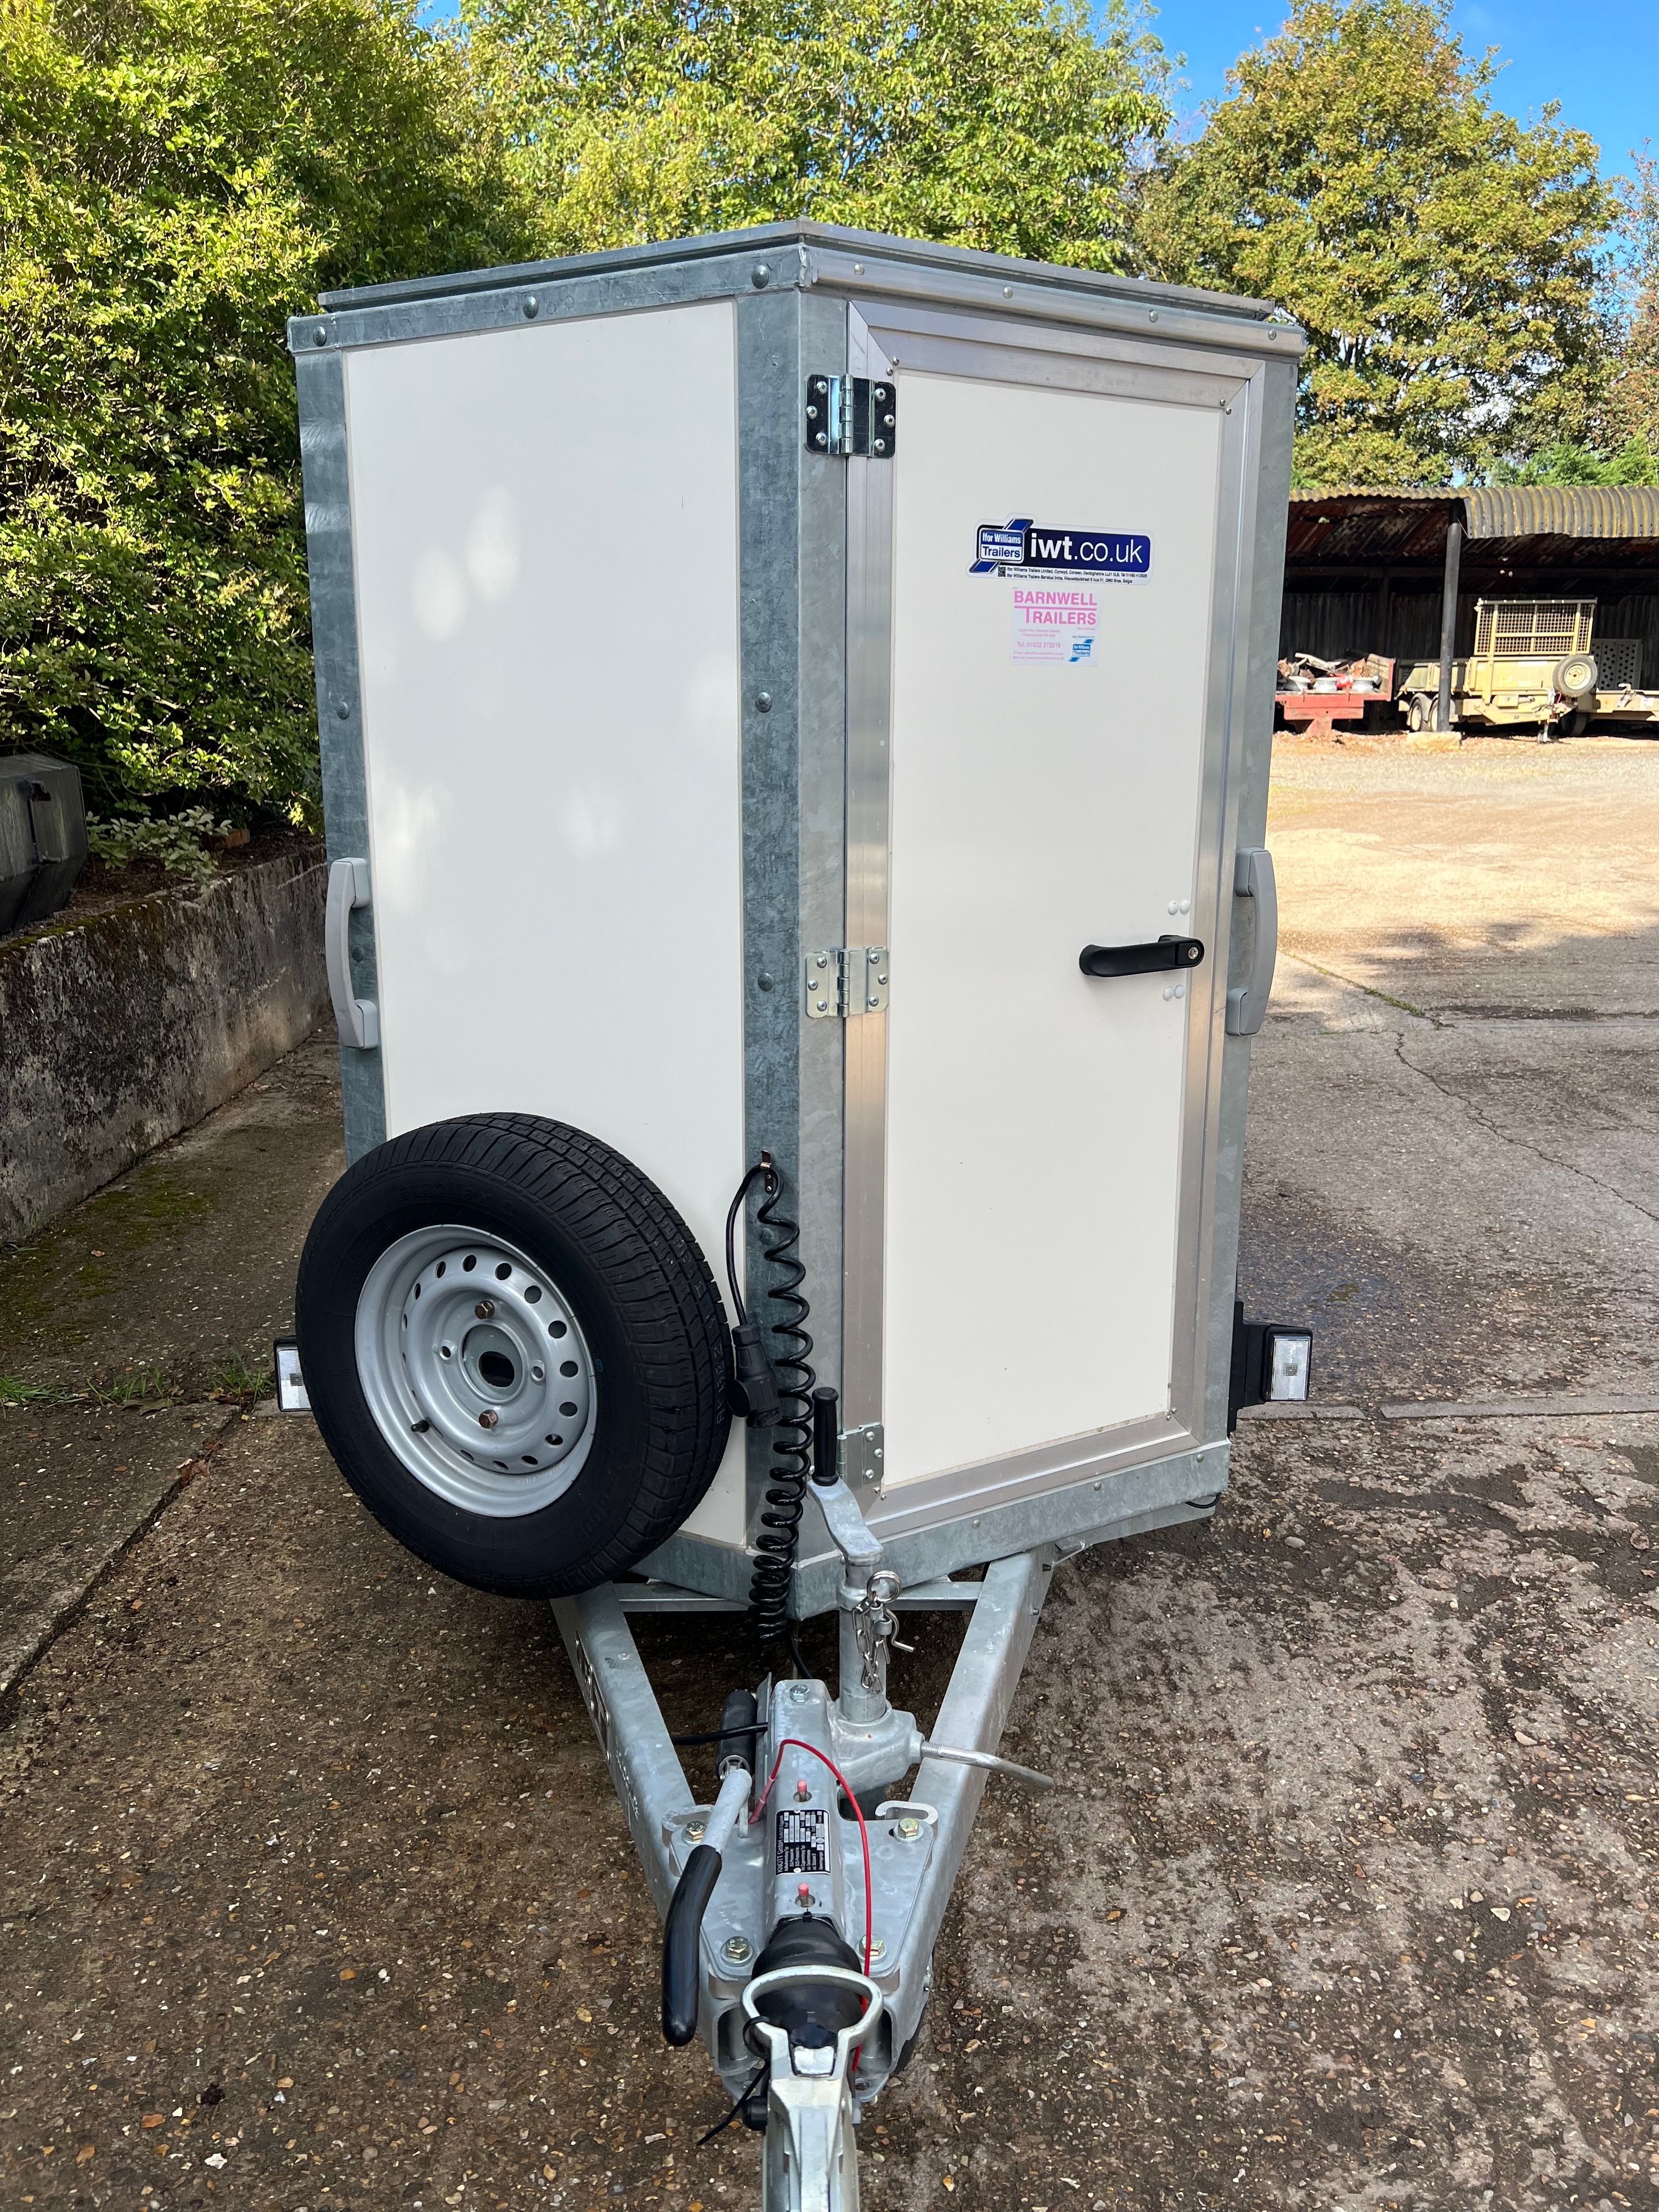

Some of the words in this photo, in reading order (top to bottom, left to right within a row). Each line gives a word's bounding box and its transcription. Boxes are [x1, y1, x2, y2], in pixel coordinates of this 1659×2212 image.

[983, 532, 993, 542] Ifor
[994, 533, 1021, 544] Williams
[983, 546, 1020, 558] Trailers
[1030, 532, 1143, 563] iwt.co.uk
[1014, 590, 1097, 606] BARNWELL
[1025, 606, 1096, 625] TRAILERS
